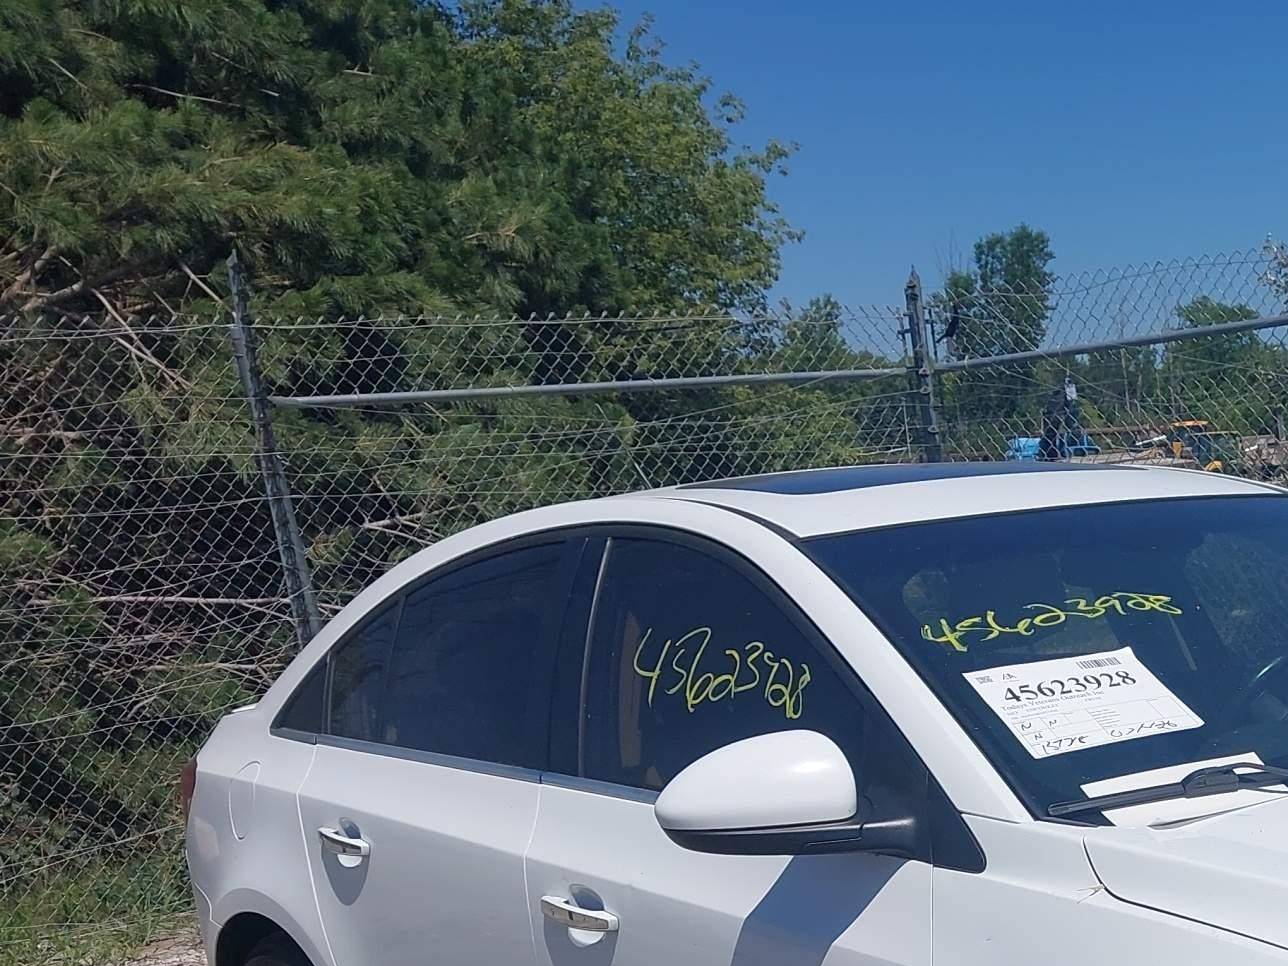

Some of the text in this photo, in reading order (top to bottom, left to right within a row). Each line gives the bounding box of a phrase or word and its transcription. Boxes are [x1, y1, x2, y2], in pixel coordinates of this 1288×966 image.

[920, 592, 1182, 652] 45623928
[633, 626, 812, 719] 45623928
[1004, 670, 1137, 702] 45623928
